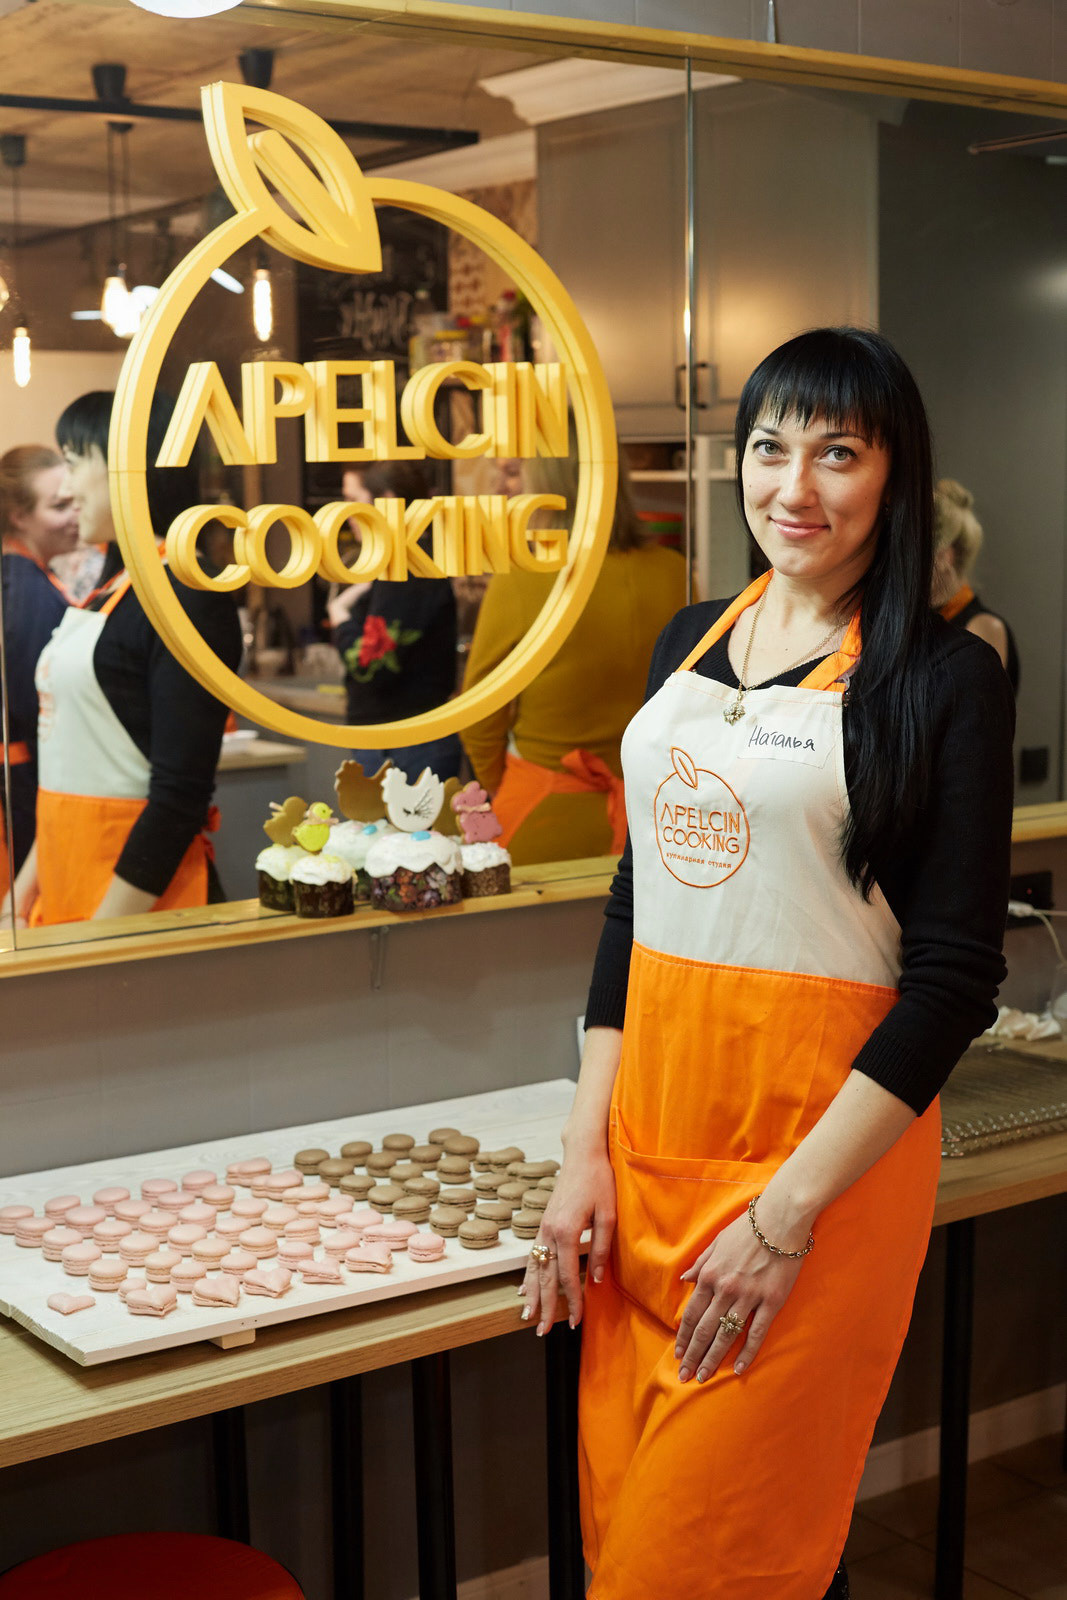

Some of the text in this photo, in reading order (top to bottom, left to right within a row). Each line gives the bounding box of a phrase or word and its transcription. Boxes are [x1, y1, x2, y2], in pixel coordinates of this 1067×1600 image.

[155, 360, 568, 468] APELCIN
[165, 494, 568, 592] COOKING
[748, 725, 816, 751] Наталья
[660, 802, 740, 834] APELCIN
[663, 826, 740, 854] COOKING
[707, 860, 732, 869] студия
